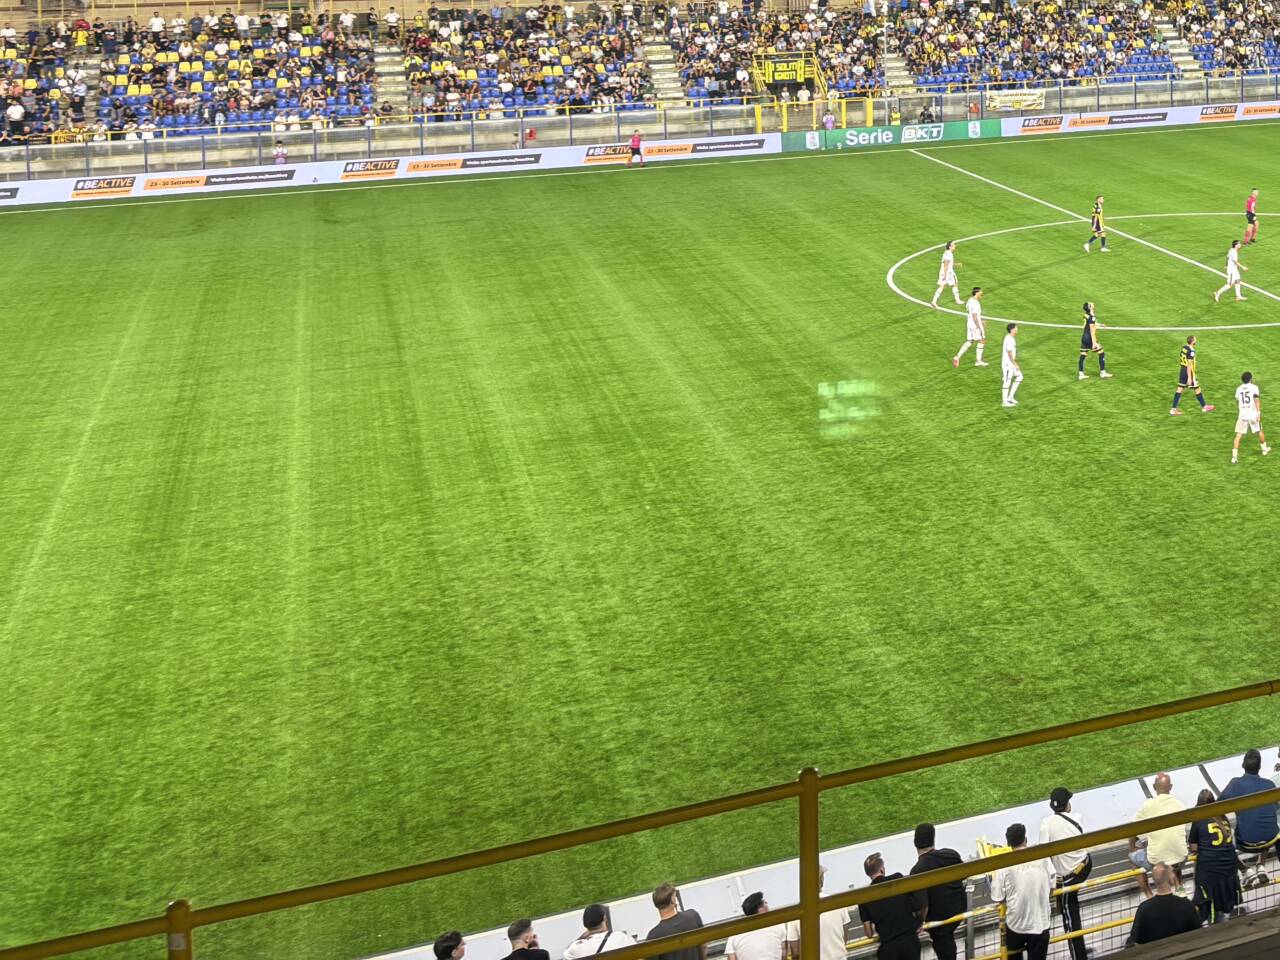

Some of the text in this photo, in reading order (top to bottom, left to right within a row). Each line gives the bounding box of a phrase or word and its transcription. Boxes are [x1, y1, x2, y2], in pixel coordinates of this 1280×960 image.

[845, 126, 942, 146] Serie BKT
[588, 146, 632, 156] #BEACTIV
[345, 158, 398, 172] #BEACTIVE
[77, 176, 133, 190] #BEACTIVE
[1239, 390, 1251, 405] 15
